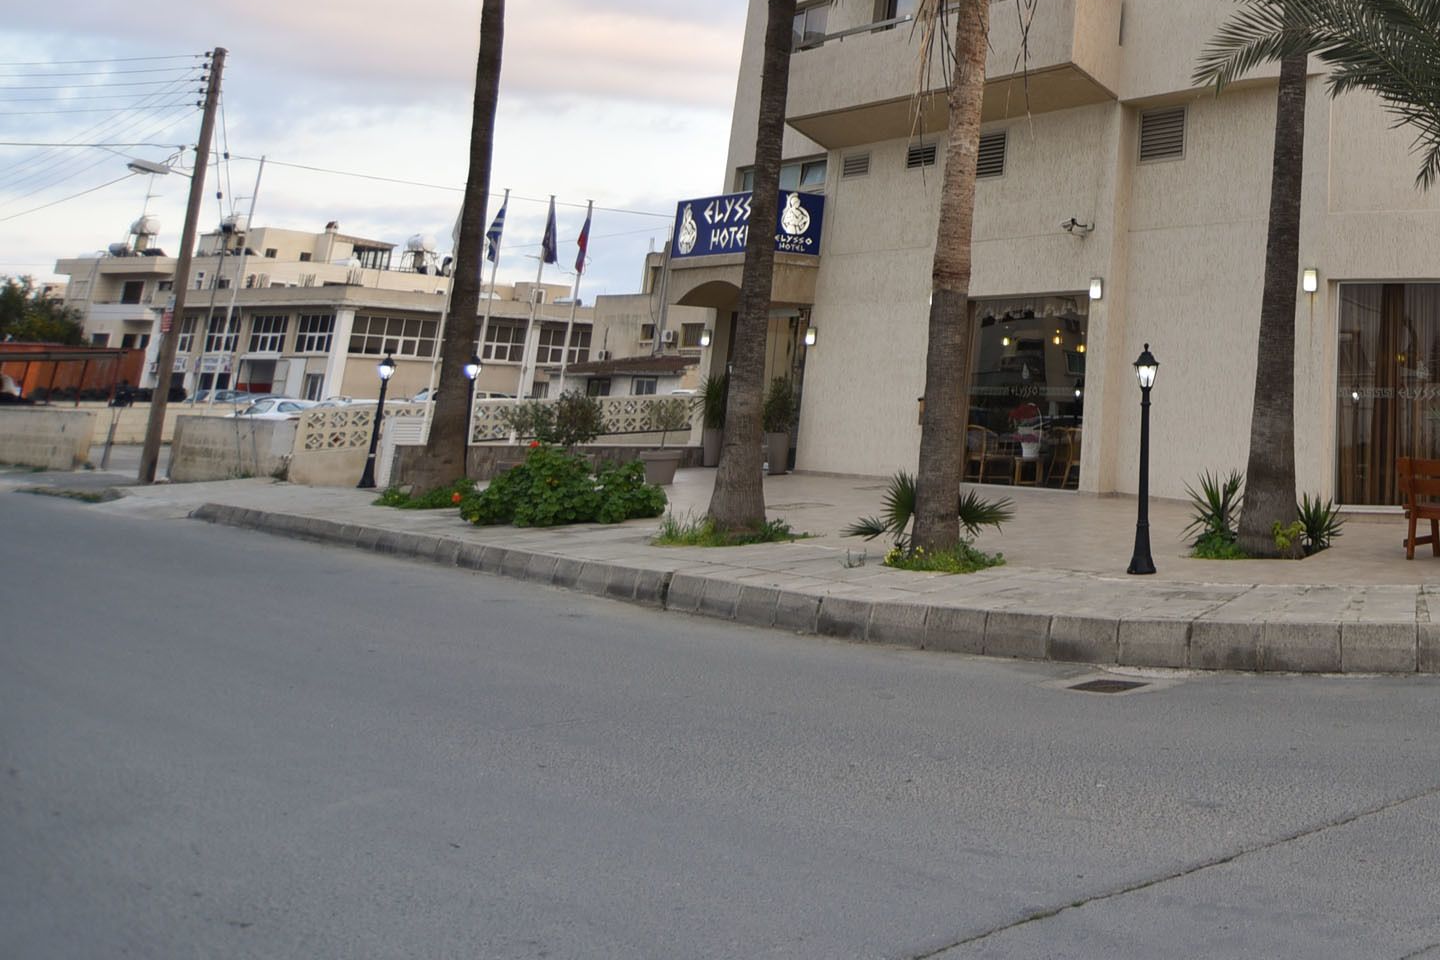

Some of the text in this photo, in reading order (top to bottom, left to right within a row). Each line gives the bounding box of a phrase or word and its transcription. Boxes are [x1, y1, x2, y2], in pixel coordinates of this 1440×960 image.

[704, 195, 752, 224] ELYSS
[774, 234, 813, 245] ELYSSO
[779, 243, 805, 252] HOTEL
